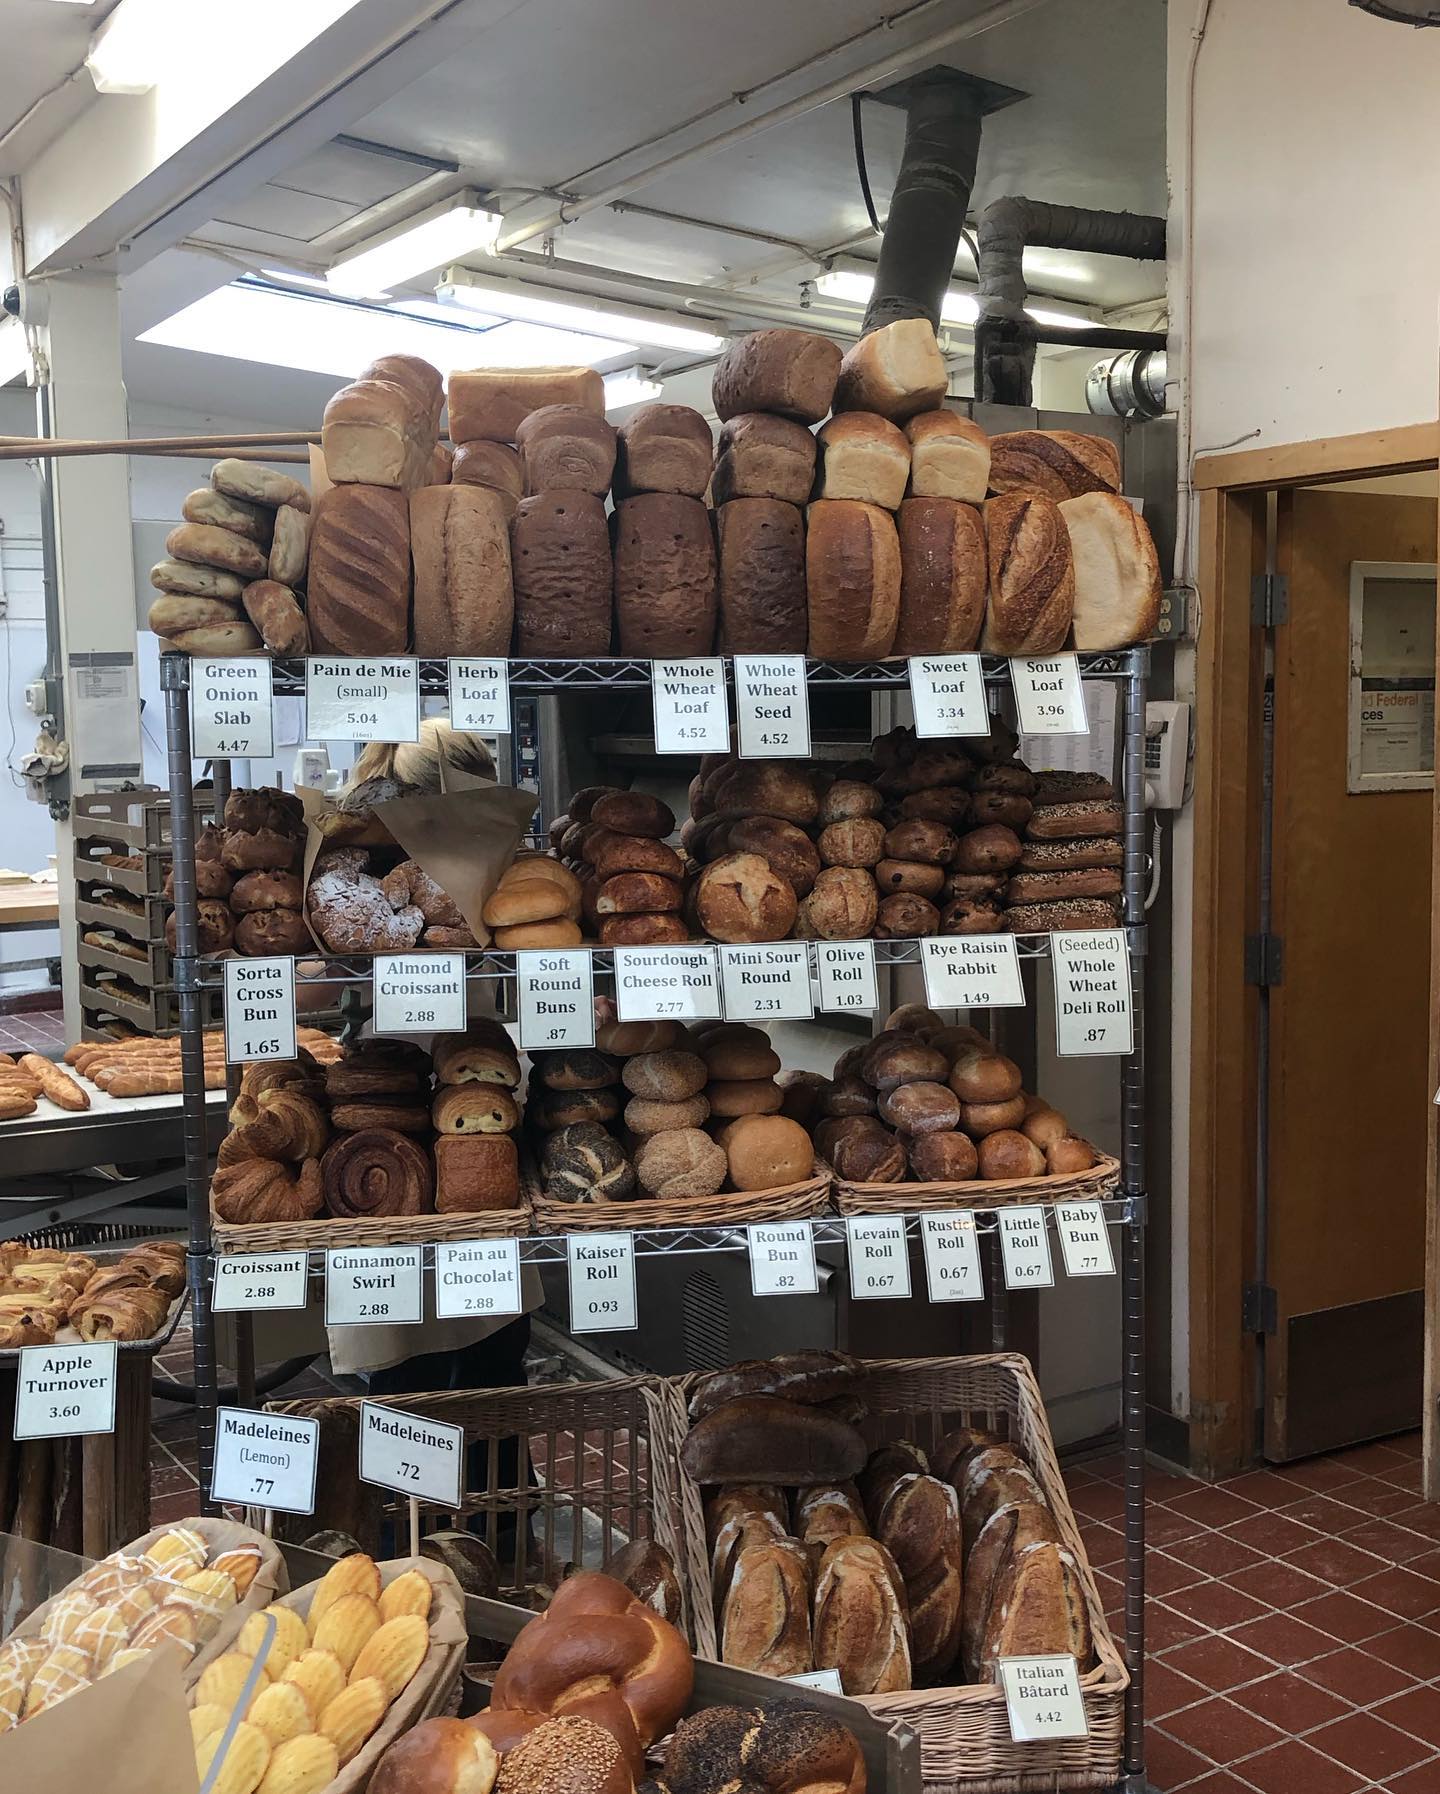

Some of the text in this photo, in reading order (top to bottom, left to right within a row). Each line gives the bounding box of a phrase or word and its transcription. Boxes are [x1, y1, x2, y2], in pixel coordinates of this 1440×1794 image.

[205, 665, 257, 678] Green
[314, 664, 411, 678] Pain de Mie
[458, 666, 498, 679] Herb
[663, 666, 714, 677] Whole
[745, 664, 796, 677] Whole
[922, 662, 968, 673] Sweet
[1027, 661, 1061, 673] Sour
[664, 683, 716, 695] Wheat
[746, 683, 798, 696] Wheat
[931, 680, 965, 693] Loaf
[1031, 678, 1064, 691] Loaf
[206, 688, 258, 701] Onion
[337, 684, 387, 700] (small)
[462, 687, 498, 700] Loaf
[674, 701, 710, 714] Loaf
[755, 705, 792, 719] Seed
[937, 708, 965, 718] 3.34
[1037, 705, 1064, 716] 3.96
[214, 711, 251, 725] Slab
[347, 713, 378, 724] 5.04
[465, 714, 495, 724] 4.47
[678, 727, 707, 738] 4.52
[760, 733, 789, 744] 4.52
[217, 740, 249, 751] 4.47
[929, 942, 1008, 958] Rye Raisin
[1059, 937, 1120, 955] (Seeded)
[624, 954, 708, 969] Sourdough
[728, 951, 801, 965] Mini Sour
[826, 949, 865, 962] Olive
[386, 961, 451, 975] Almond
[539, 957, 571, 971] Soft
[947, 962, 997, 975] Rabbit
[1068, 959, 1115, 973] Whole
[237, 967, 282, 981] Sorta
[741, 970, 791, 984] Round
[832, 967, 862, 981] Roll
[529, 977, 581, 991] Round
[623, 974, 712, 988] Cheese Roll
[1069, 979, 1117, 992] Wheat
[237, 988, 283, 1001] Cross
[381, 981, 459, 995] Croissant
[754, 999, 782, 1010] 2.31
[836, 994, 863, 1006] 1.03
[963, 993, 991, 1005] 1.49
[536, 1001, 576, 1014] Buns
[656, 1002, 684, 1013] 2.77
[1063, 1000, 1125, 1015] Deli Roll
[244, 1008, 277, 1021] Bun
[405, 1010, 435, 1022] 2.88
[546, 1028, 567, 1040] .87
[1084, 1029, 1106, 1042] .87
[244, 1039, 280, 1055] 1.65
[1061, 1209, 1097, 1223] Baby
[927, 1219, 969, 1232] Rustic
[1004, 1218, 1040, 1231] Little
[756, 1229, 806, 1243] Round
[854, 1227, 900, 1240] Levain
[1069, 1231, 1099, 1242] Bun
[937, 1236, 964, 1249] Roll
[1011, 1235, 1039, 1248] Roll
[448, 1249, 507, 1262] Pain au
[576, 1246, 627, 1260] Kaiser
[768, 1249, 798, 1261] Bun
[865, 1245, 892, 1258] Roll
[222, 1261, 301, 1275] Croissant
[333, 1255, 416, 1269] Cinnamon
[1081, 1257, 1098, 1268] .77
[443, 1269, 514, 1285] Chocolat
[587, 1265, 618, 1280] Roll
[940, 1266, 968, 1279] 0.67
[1015, 1265, 1041, 1277] 0.67
[353, 1274, 395, 1289] Swirl
[775, 1275, 795, 1287] .82
[867, 1275, 894, 1287] 0.67
[245, 1287, 275, 1298] 2.88
[464, 1297, 494, 1309] 2.88
[589, 1300, 618, 1313] 0.93
[359, 1304, 389, 1316] 2.88
[42, 1356, 92, 1374] Apple
[26, 1374, 108, 1393] Turnover
[49, 1405, 80, 1418] 3.60
[224, 1418, 311, 1444] Madeleines
[369, 1414, 454, 1451] Madeleines
[240, 1447, 290, 1470] (Lemon)
[397, 1462, 420, 1480] .72
[250, 1478, 274, 1495] .77
[1017, 1666, 1064, 1679] Italian
[1018, 1684, 1069, 1698] Bâtard
[1035, 1711, 1062, 1723] 4.42
